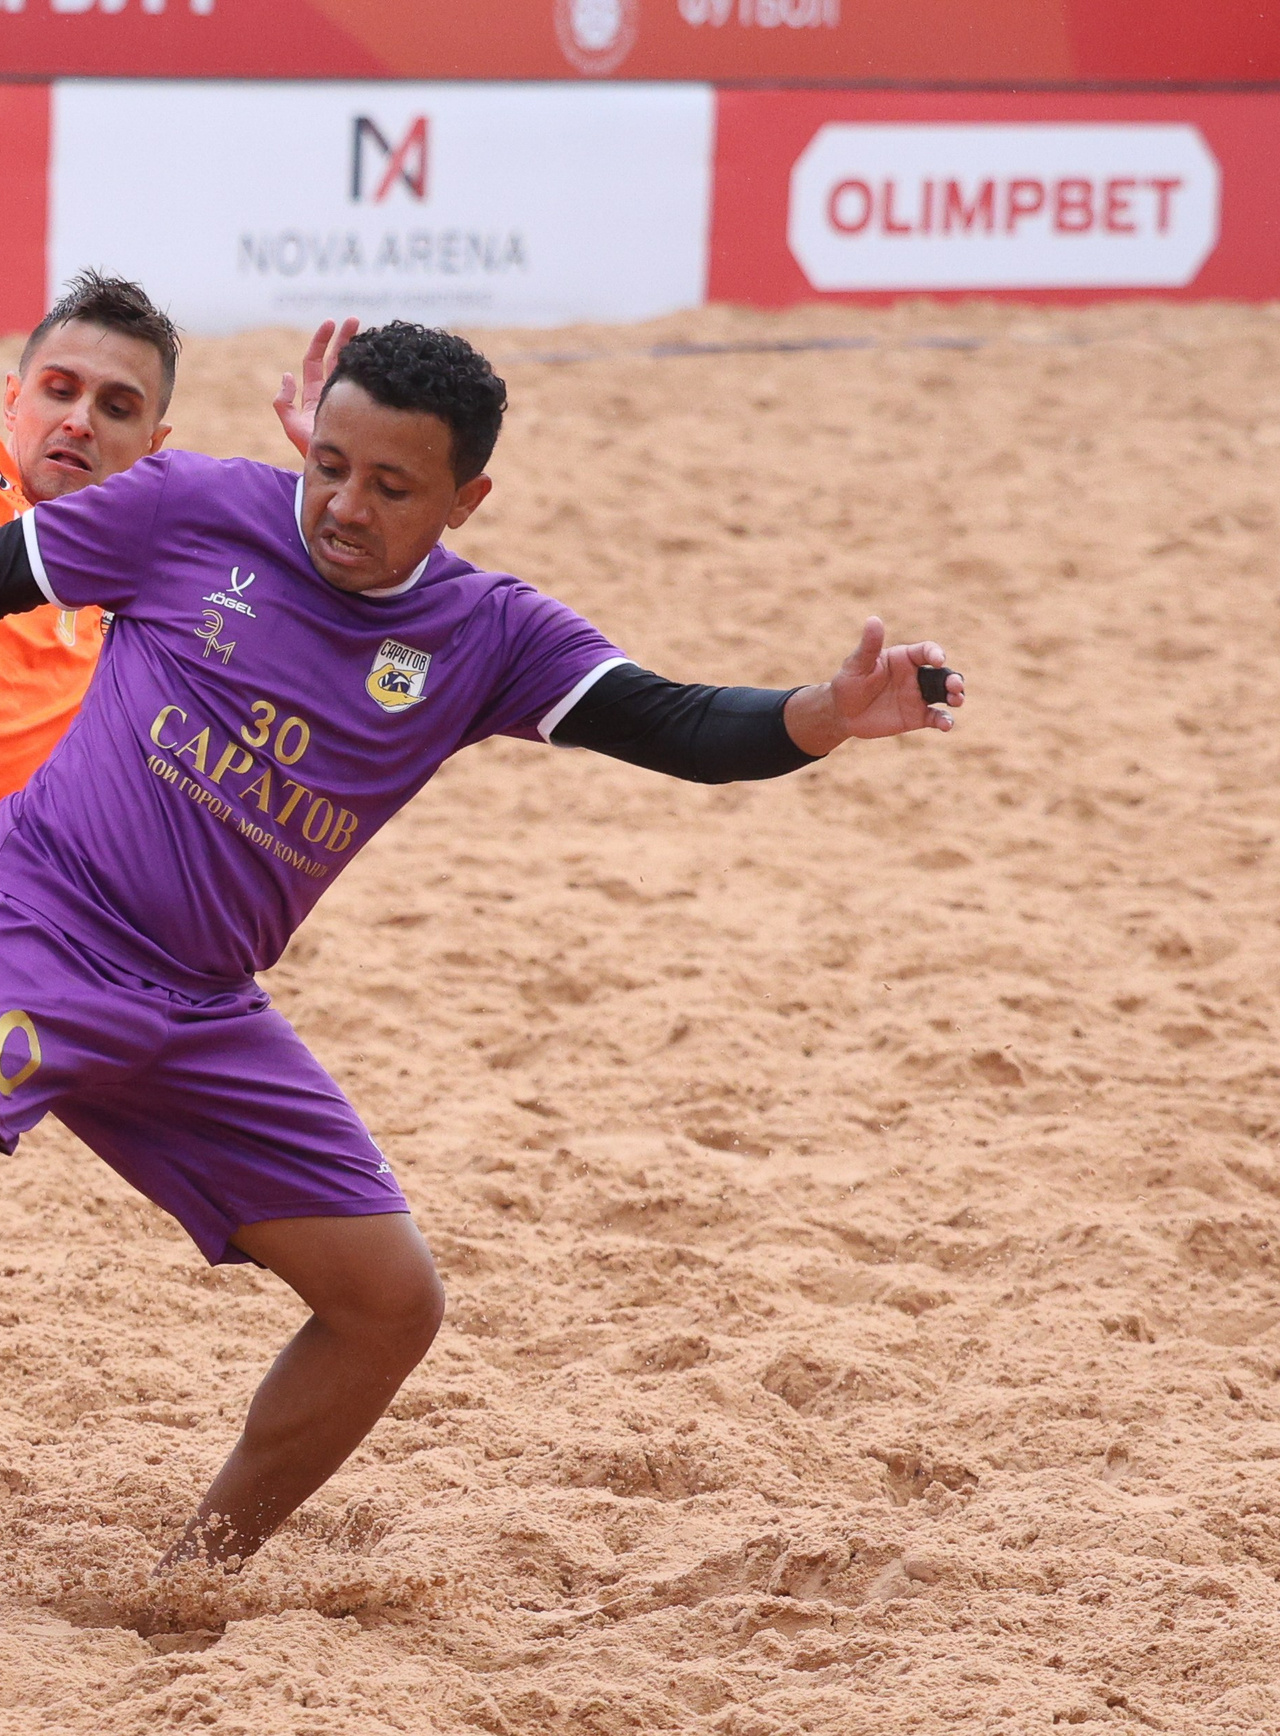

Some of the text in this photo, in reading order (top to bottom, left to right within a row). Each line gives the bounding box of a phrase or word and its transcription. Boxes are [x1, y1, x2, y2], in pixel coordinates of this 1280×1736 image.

[826, 177, 1184, 235] OLIMPBET
[236, 229, 530, 277] NOVA ARENA
[202, 592, 257, 618] JÖGEL
[380, 641, 427, 671] САРАТОВ
[240, 700, 311, 766] 30
[149, 705, 359, 853] САРАТОВ
[178, 776, 233, 823] ГОРОД
[237, 817, 274, 850] МОЯ
